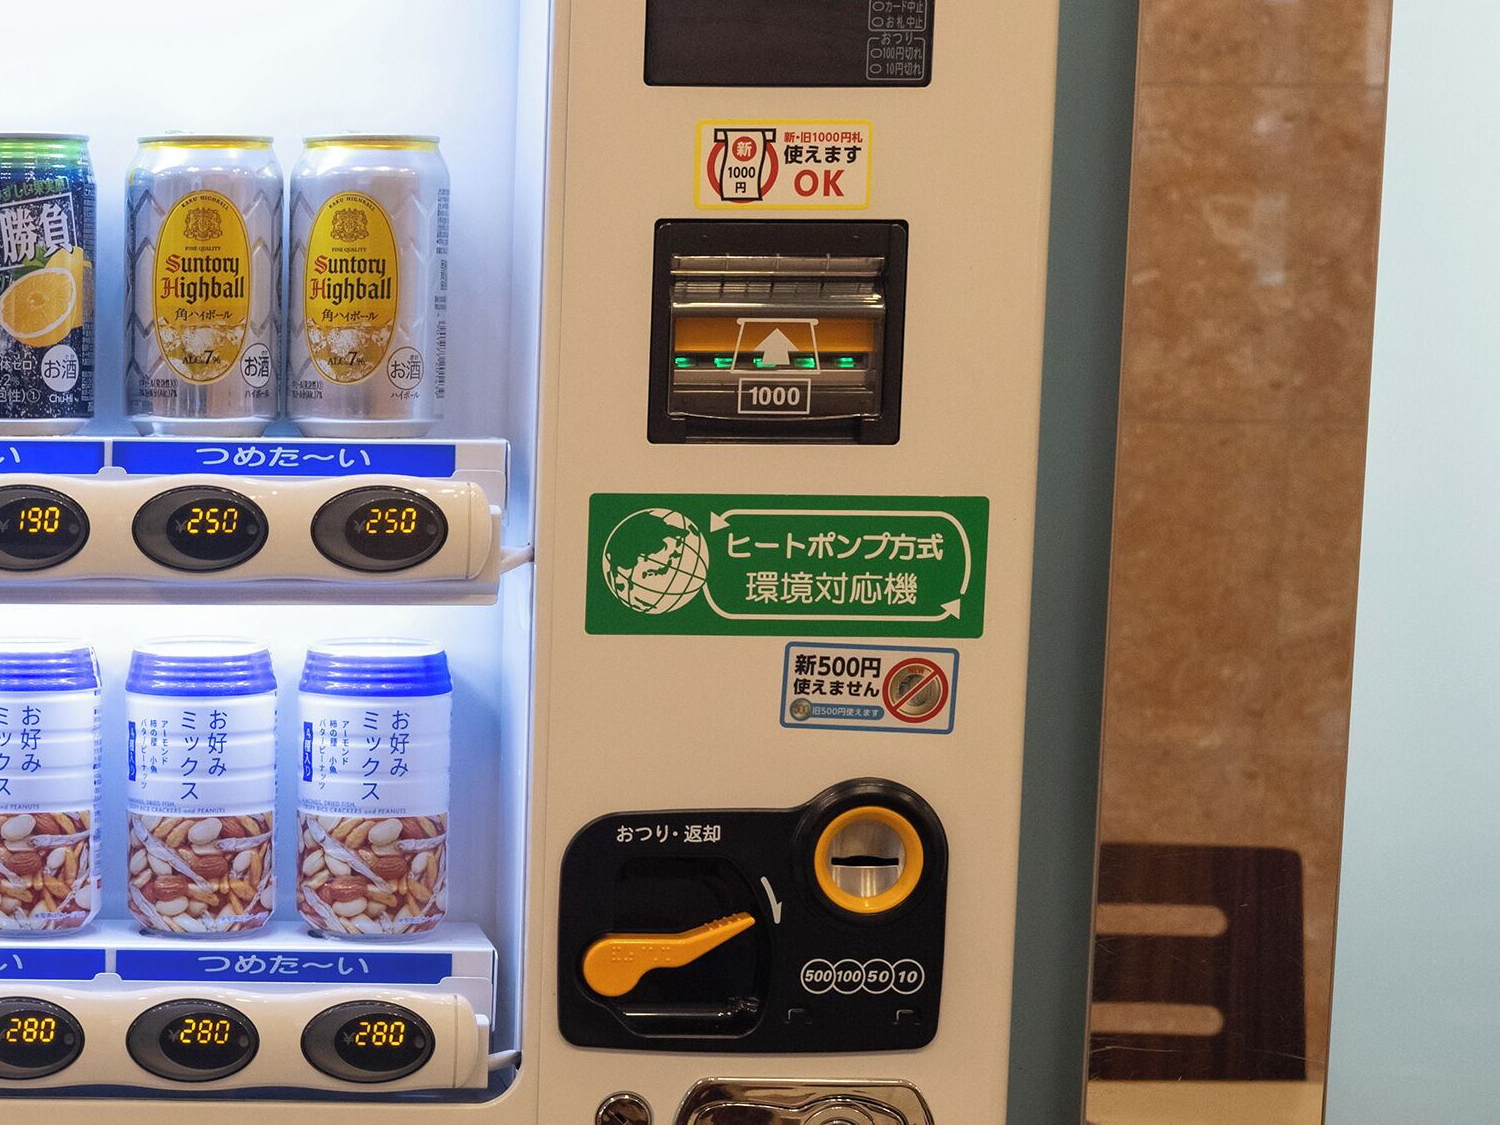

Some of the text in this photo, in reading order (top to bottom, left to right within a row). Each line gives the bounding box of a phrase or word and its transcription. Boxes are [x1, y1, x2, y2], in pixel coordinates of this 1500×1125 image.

[885, 0, 923, 13] カード中止
[881, 32, 913, 45] おつり
[737, 141, 752, 157] 新
[784, 145, 861, 164] 使えます
[728, 167, 756, 178] 1000
[794, 169, 845, 197] OK
[735, 182, 746, 193] 円
[165, 254, 240, 276] Suntory
[314, 255, 386, 278] Suntory
[160, 276, 245, 305] Highball
[309, 277, 392, 305] Highball
[175, 307, 232, 321] 角ハイボール
[321, 309, 378, 322] 角ハイボール
[44, 360, 77, 380] お酒
[390, 360, 421, 379] お酒
[750, 386, 800, 406] 1000
[19, 507, 60, 533] 190
[187, 508, 238, 534] 250
[366, 508, 417, 534] 250
[727, 532, 944, 561] ヒートポンプ方式
[745, 571, 918, 605] 環境対応機
[795, 654, 882, 678] 新500円
[793, 678, 880, 698] 使えません
[21, 705, 41, 773] お好み
[208, 709, 228, 776] お好み
[390, 710, 410, 777] お好み
[181, 711, 199, 800] ミックス
[361, 711, 381, 800] ミックス
[616, 825, 721, 843] おつり・返却
[804, 970, 917, 983] 500 100 50 10
[6, 1018, 56, 1043] 280
[180, 1019, 230, 1044] 280
[355, 1021, 405, 1046] 280
